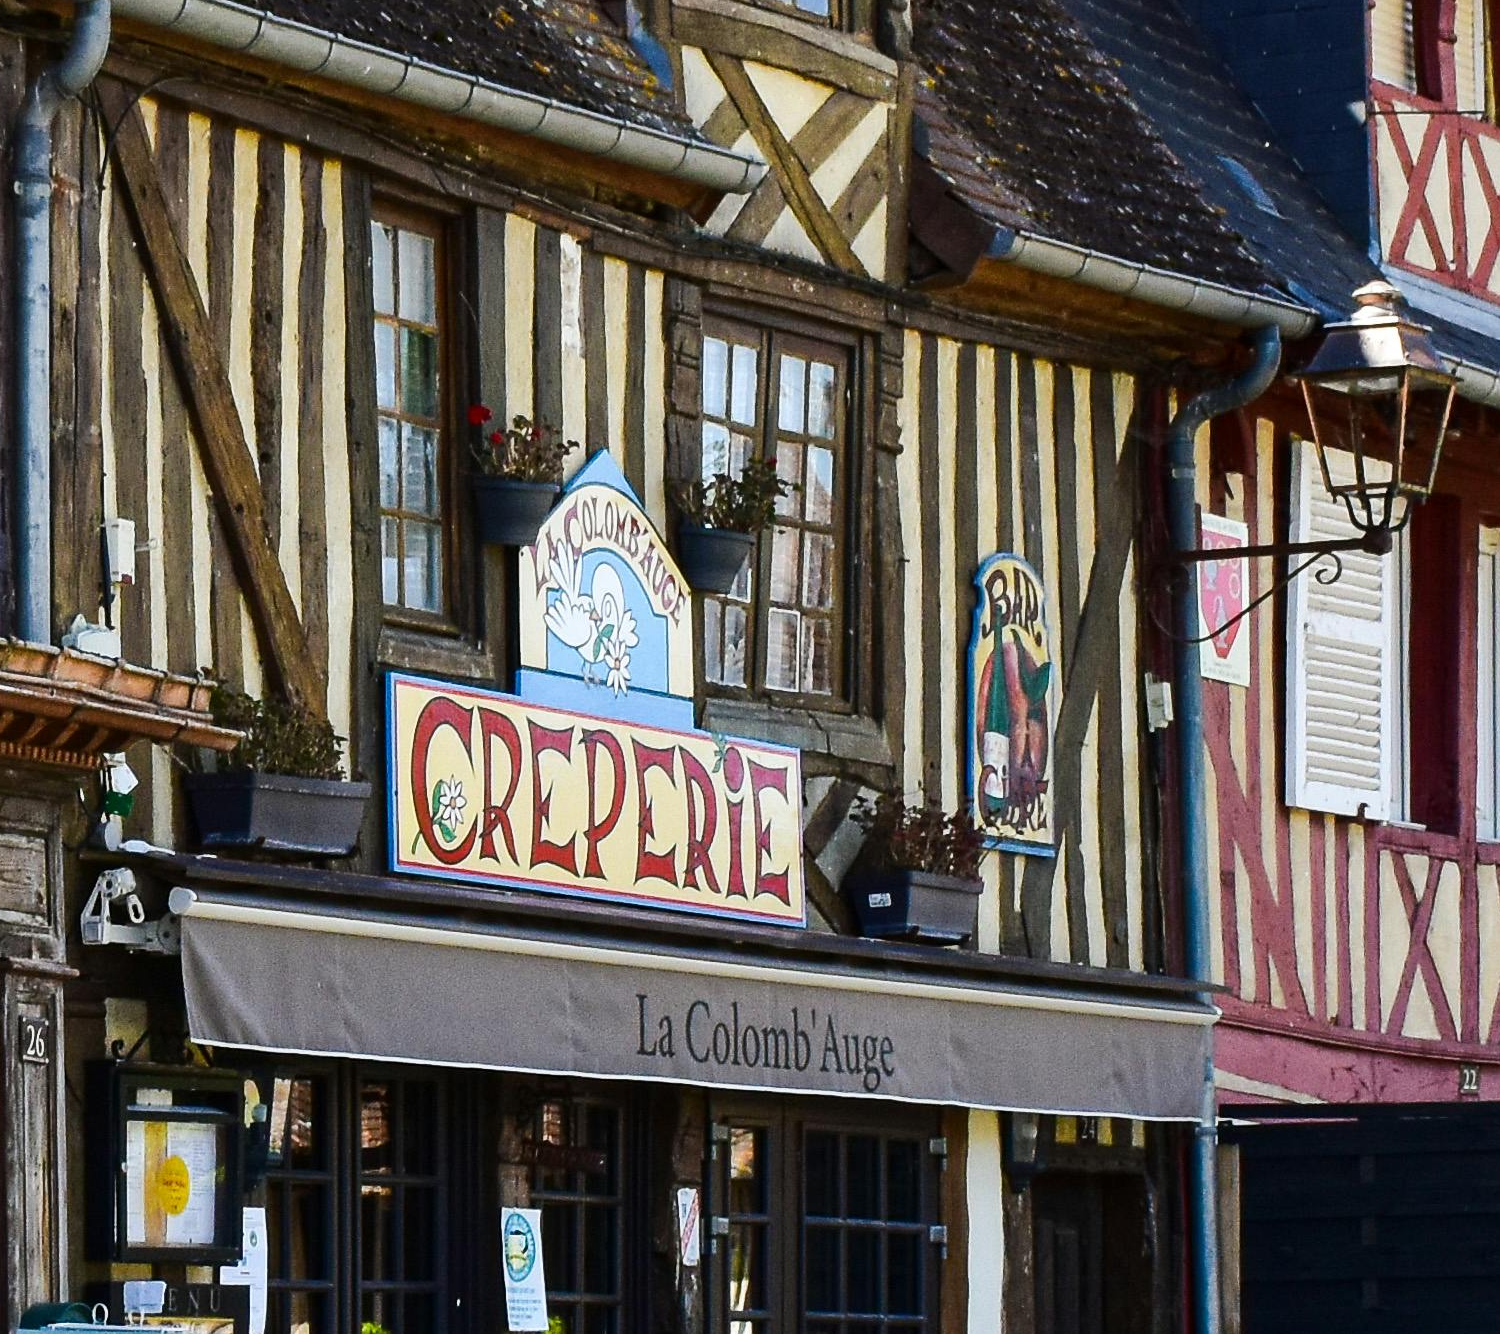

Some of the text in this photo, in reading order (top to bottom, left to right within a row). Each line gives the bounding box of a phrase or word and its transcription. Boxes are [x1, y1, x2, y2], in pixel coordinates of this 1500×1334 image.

[981, 567, 1042, 647] BAR
[26, 1023, 46, 1058] 26
[635, 993, 895, 1093] La Colomb'Auge
[1081, 1117, 1096, 1140] 24
[168, 1287, 222, 1314] ENU
